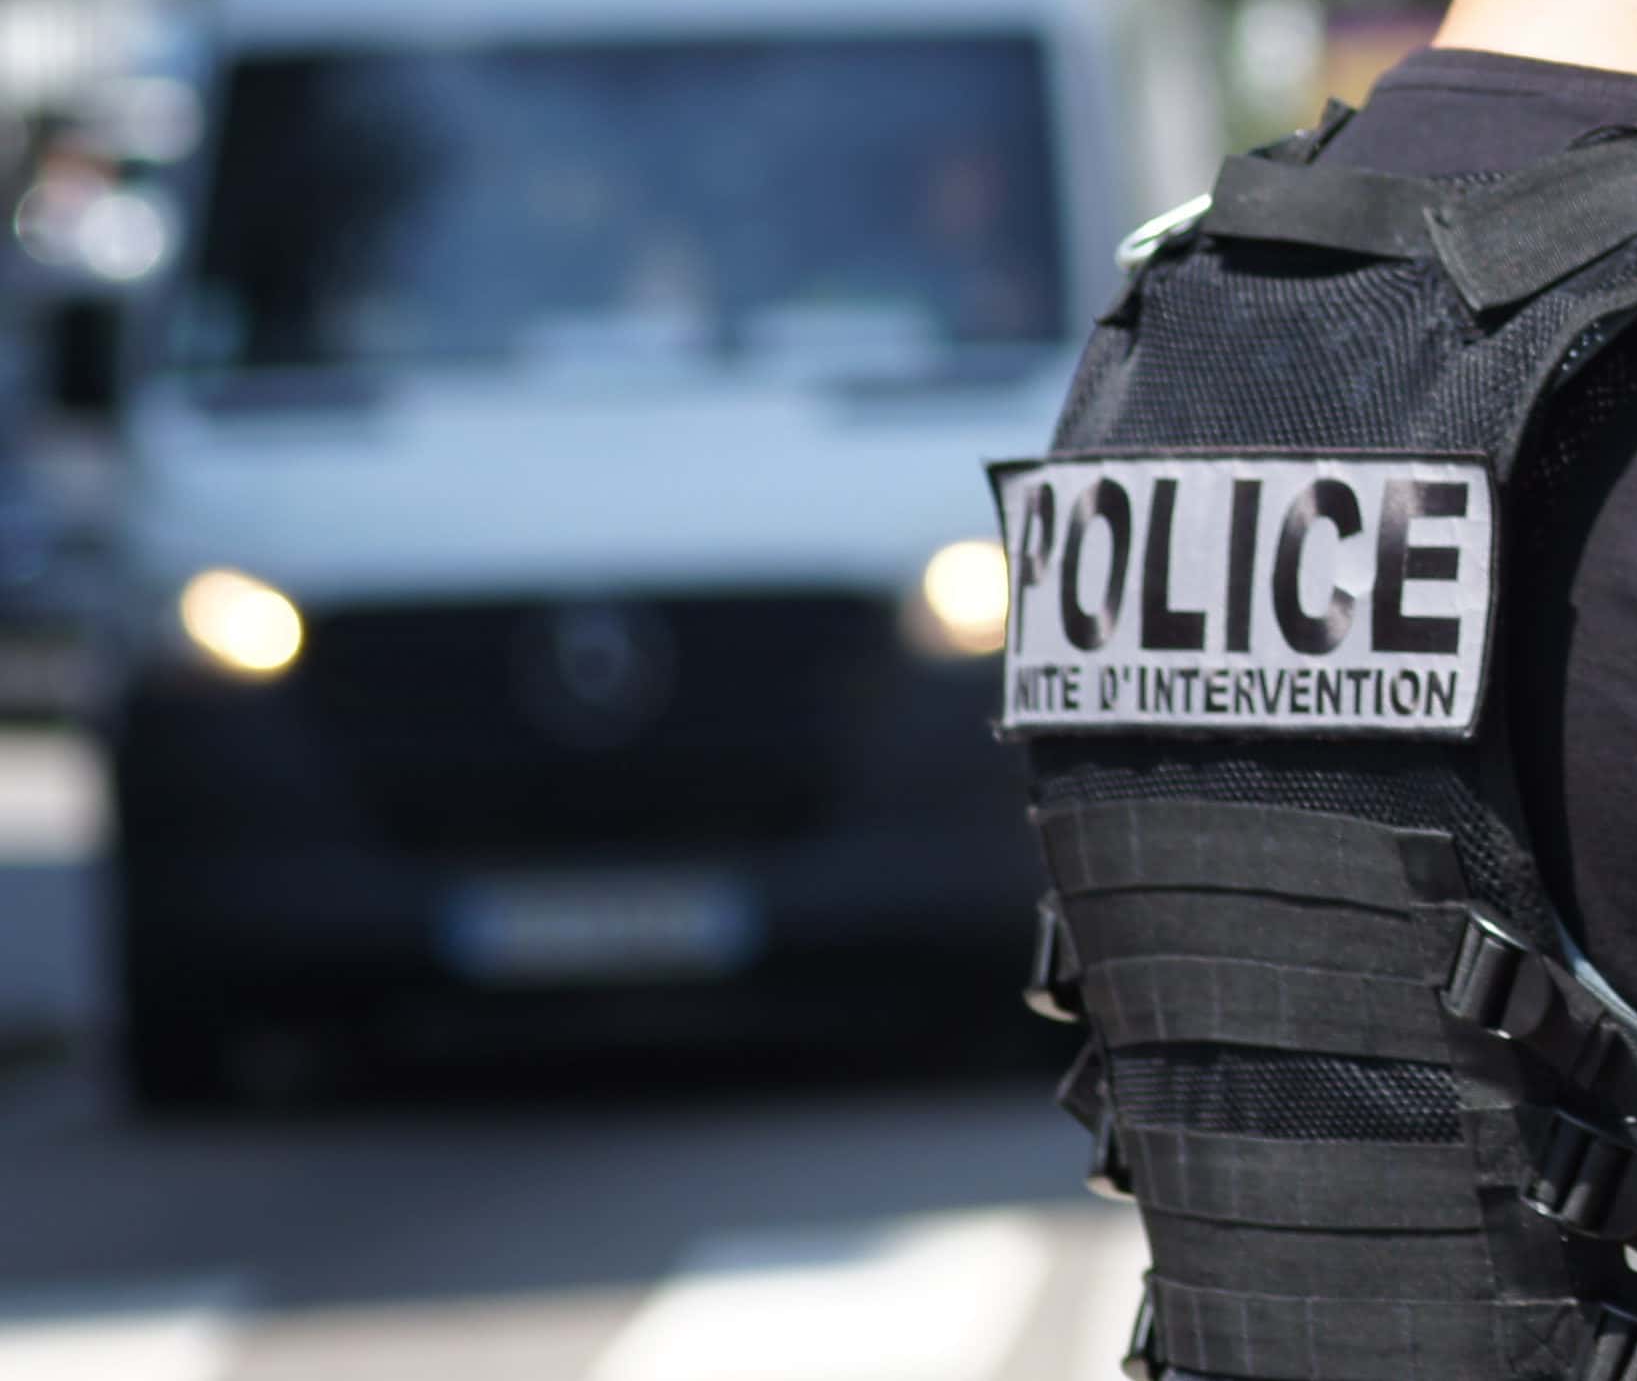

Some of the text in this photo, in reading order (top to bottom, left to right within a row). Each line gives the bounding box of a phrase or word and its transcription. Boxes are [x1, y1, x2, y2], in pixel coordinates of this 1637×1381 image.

[1014, 476, 1469, 656] POLICE
[1013, 663, 1457, 717] NITE D'INTERVENTION
